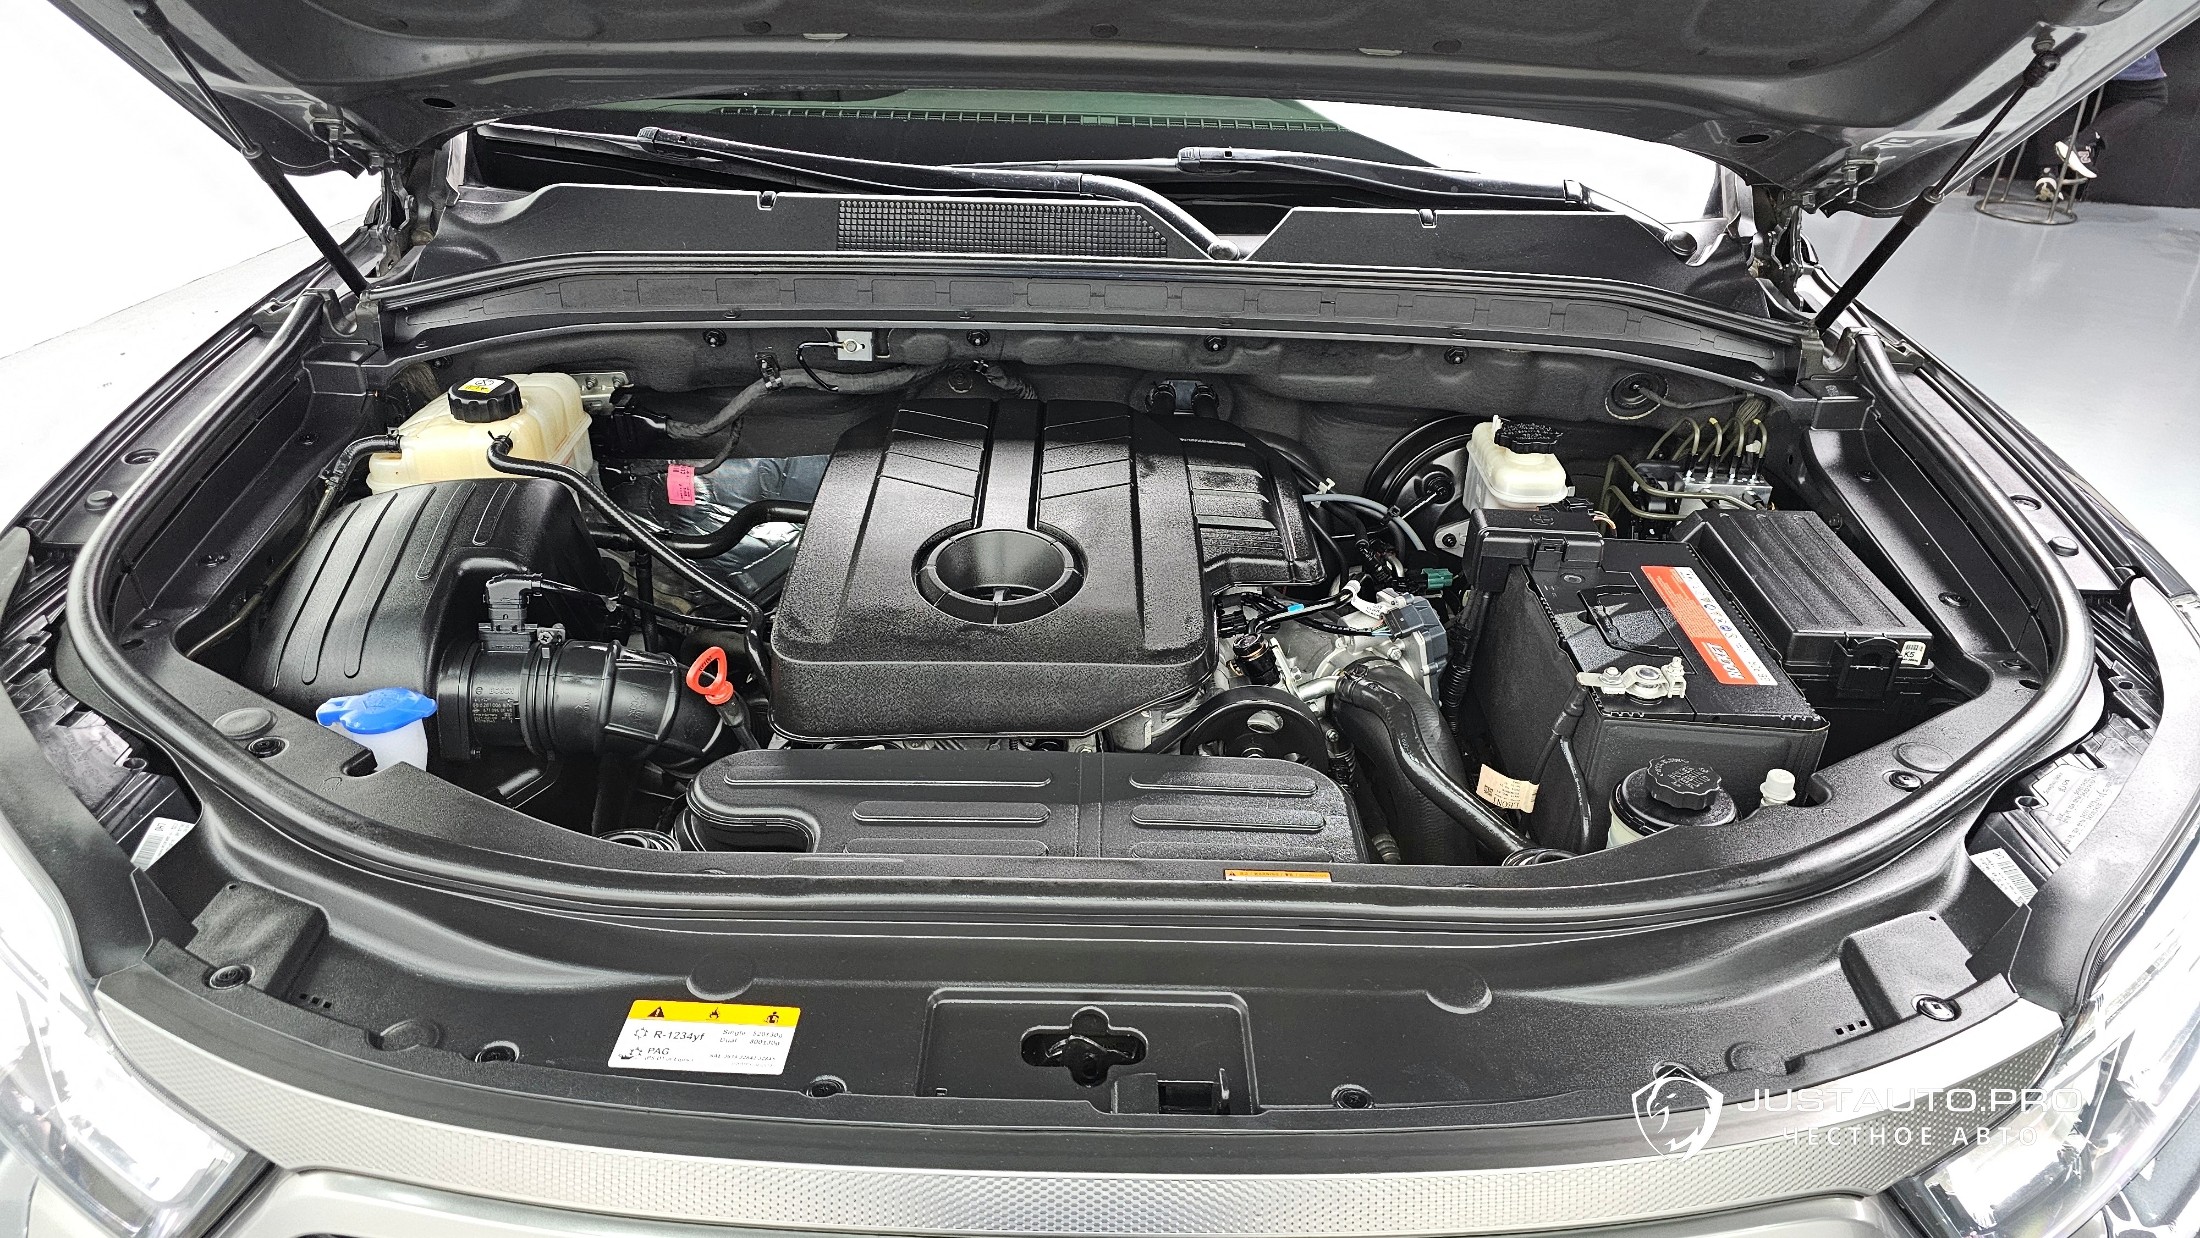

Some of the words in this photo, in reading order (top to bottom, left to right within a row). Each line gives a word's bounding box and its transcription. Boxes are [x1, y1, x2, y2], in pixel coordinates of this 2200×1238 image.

[489, 687, 514, 695] BOSCH
[654, 1030, 705, 1043] R-1234yf
[647, 1047, 670, 1056] PAG
